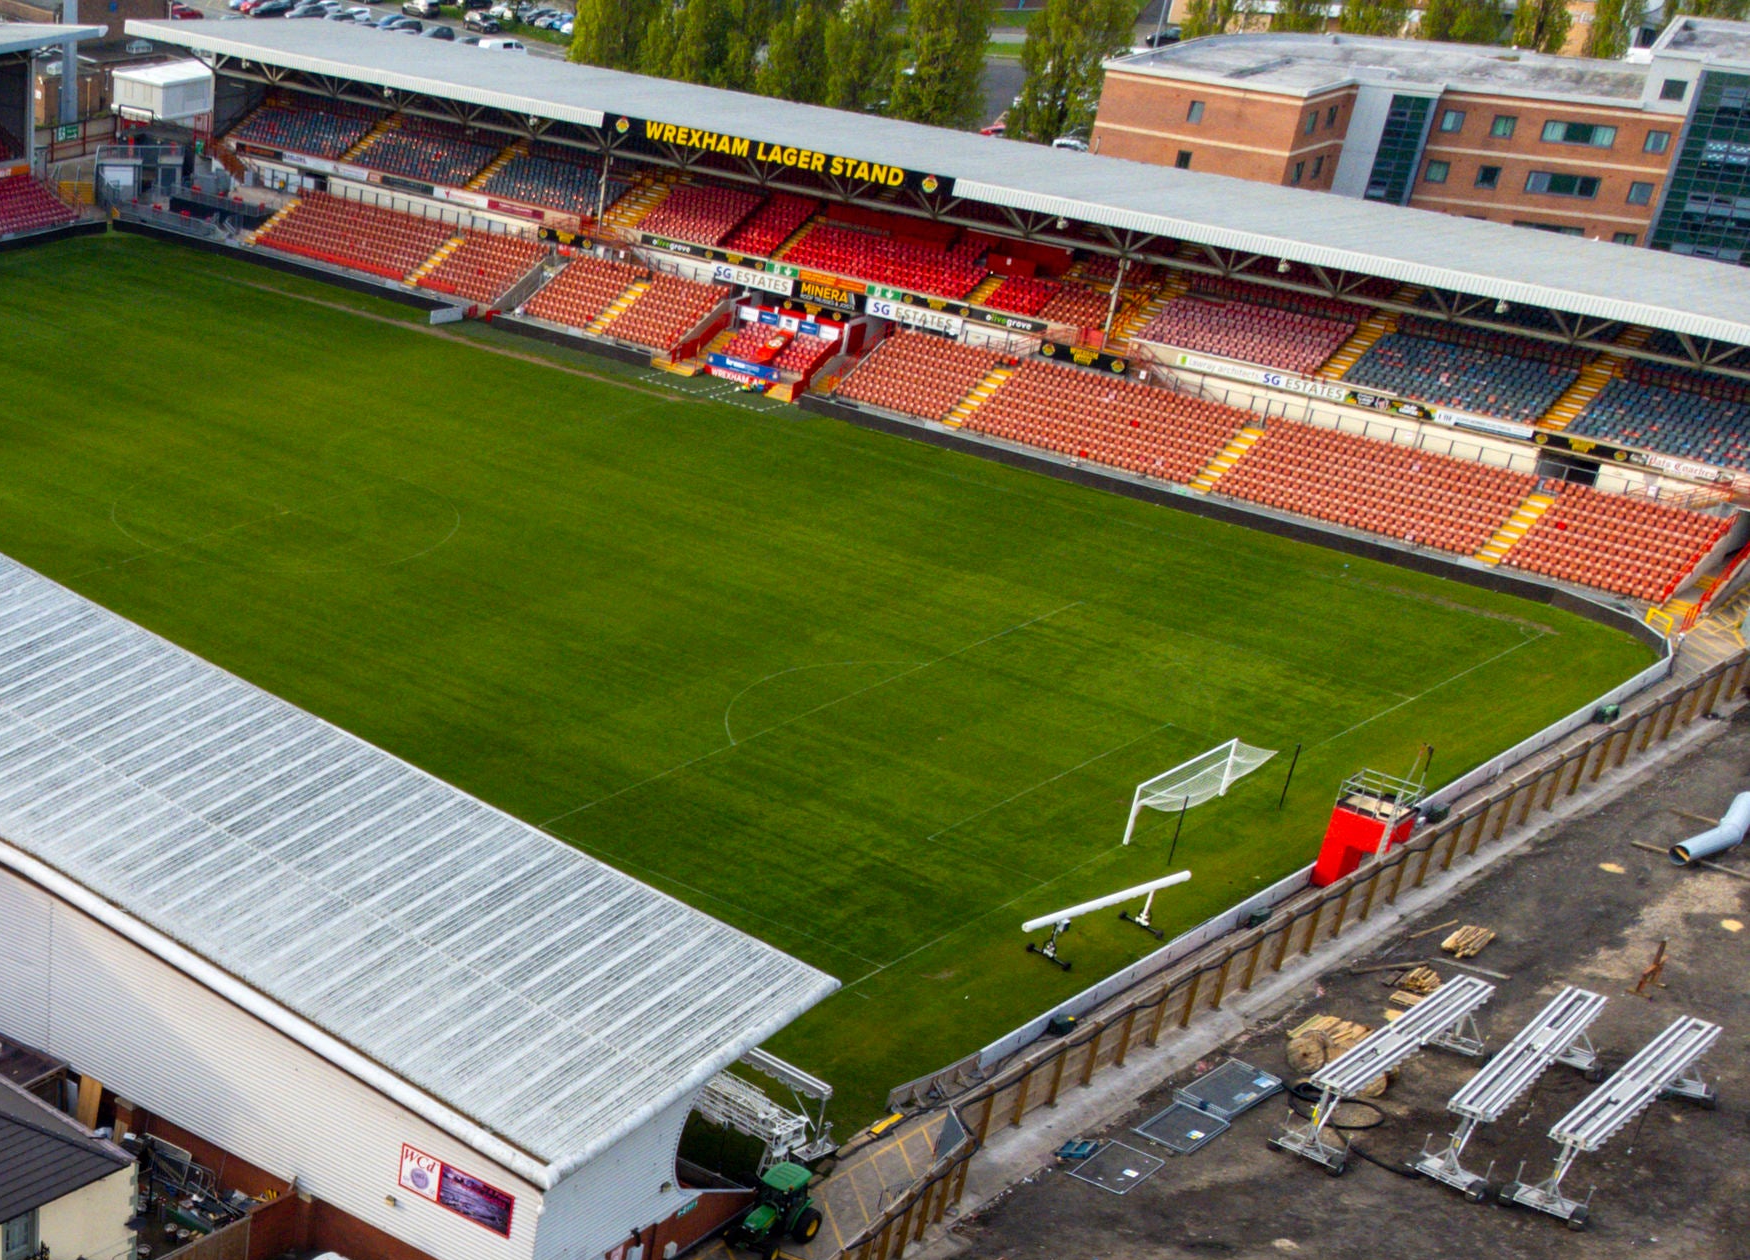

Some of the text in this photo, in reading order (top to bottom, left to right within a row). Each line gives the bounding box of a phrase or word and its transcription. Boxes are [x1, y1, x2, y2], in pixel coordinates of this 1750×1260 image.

[645, 120, 904, 186] WREXHAM LAGER STAND
[715, 265, 732, 279] SG
[736, 270, 789, 293] ESTATES
[800, 282, 848, 304] MINERA
[872, 302, 953, 330] SG ESTATES
[985, 313, 1032, 330] olivegrove
[1263, 373, 1281, 386] SG
[1285, 378, 1344, 400] ESTATES
